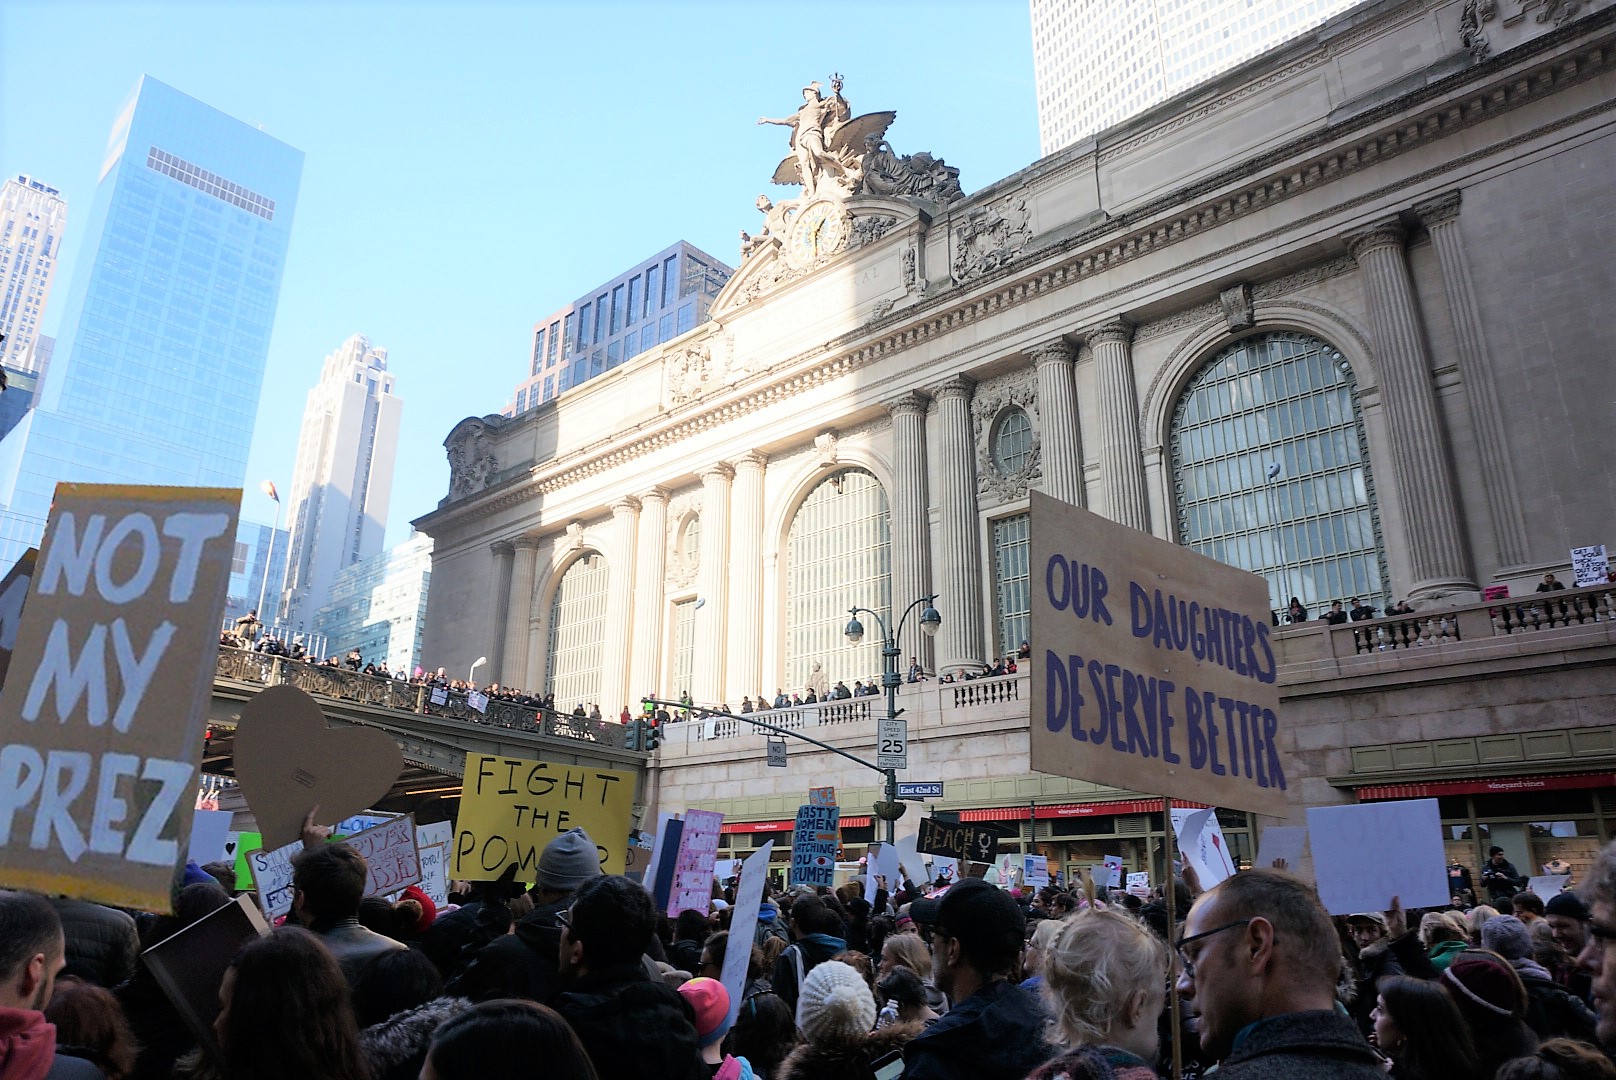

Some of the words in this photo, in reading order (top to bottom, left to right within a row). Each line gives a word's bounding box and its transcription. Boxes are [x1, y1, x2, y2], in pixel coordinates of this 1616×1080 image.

[38, 512, 230, 604] NOT
[1046, 554, 1113, 625] OUR
[1129, 581, 1276, 684] DAUGHTERS
[21, 617, 177, 733] MY
[1046, 649, 1180, 765] DESERVE
[1185, 687, 1286, 791] BETTER
[772, 745, 781, 753] NO
[882, 740, 903, 753] 25
[477, 757, 620, 805] FIGHT
[900, 786, 914, 794] East
[915, 786, 931, 794] 42nd
[931, 785, 940, 794] St
[1488, 781, 1523, 790] vineyard
[0, 743, 194, 866] PREZ
[514, 805, 570, 832] THE
[457, 830, 609, 874] POWR
